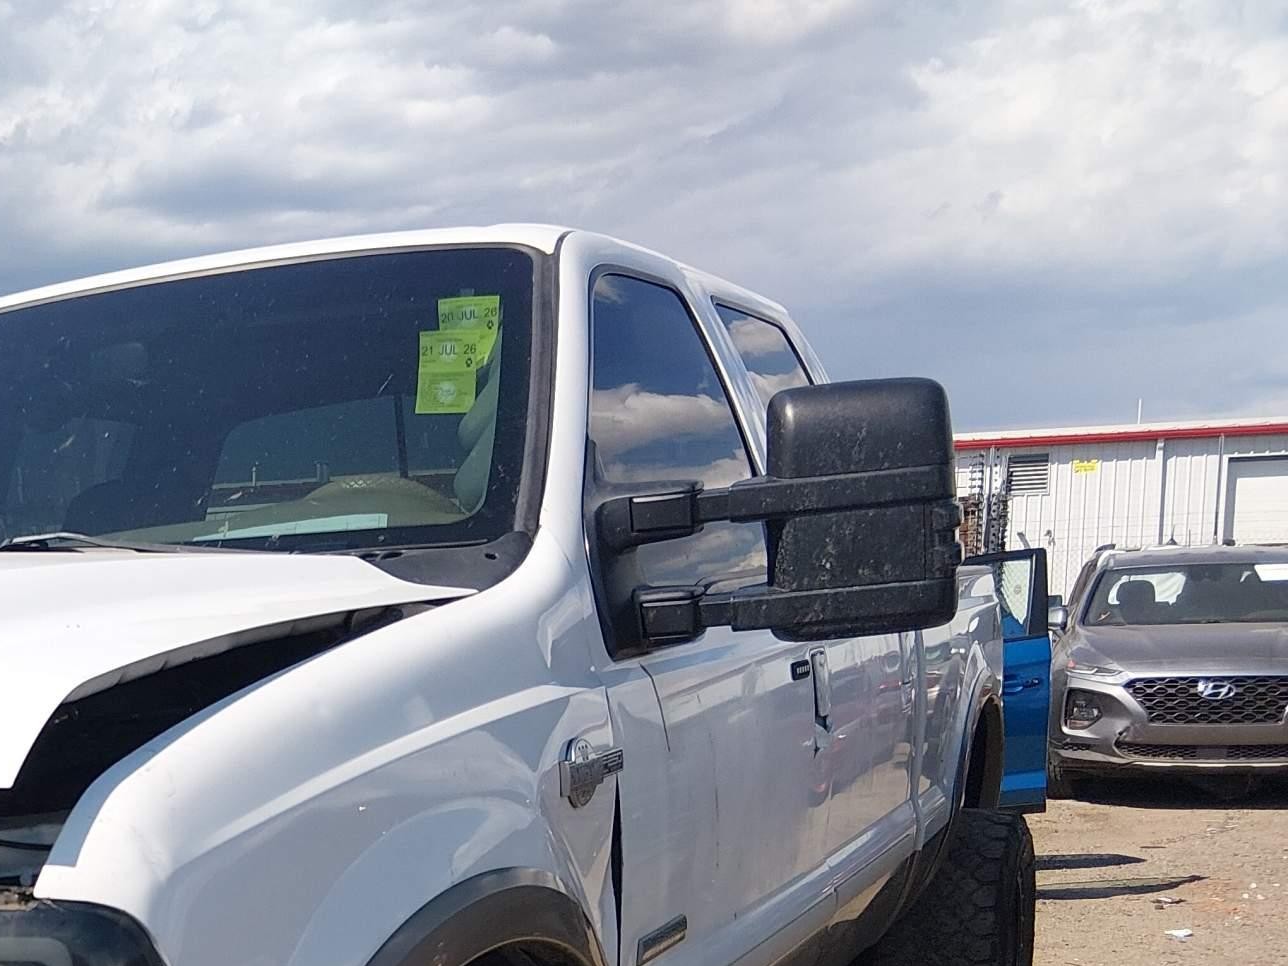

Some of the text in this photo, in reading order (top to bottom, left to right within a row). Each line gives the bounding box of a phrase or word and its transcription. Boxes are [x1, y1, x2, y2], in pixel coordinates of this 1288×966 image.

[459, 309, 479, 320] JUL
[484, 307, 497, 318] 26
[421, 344, 477, 357] 21 JUL 26
